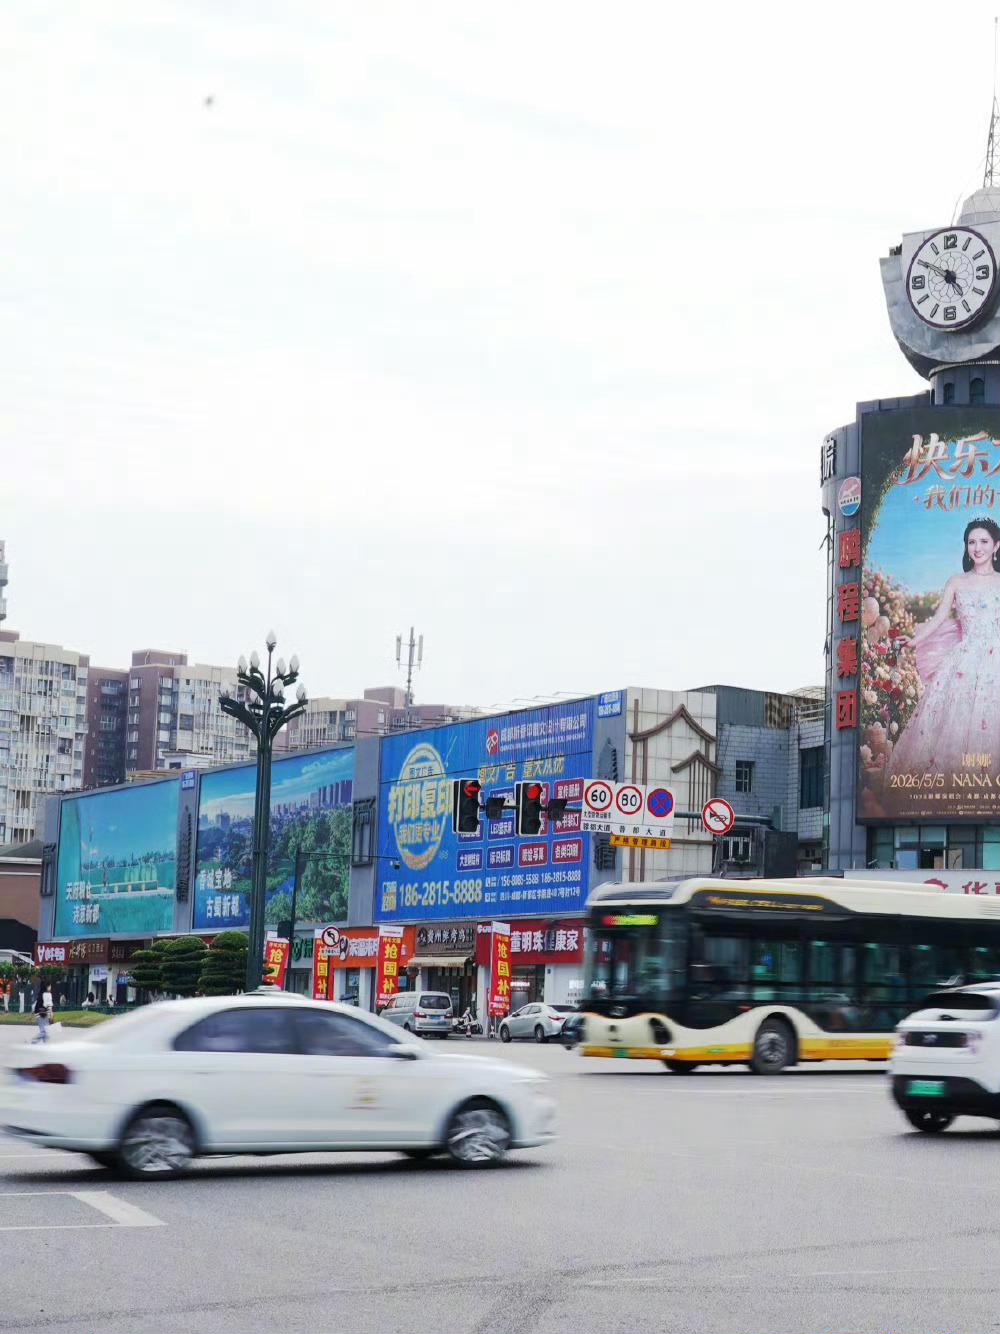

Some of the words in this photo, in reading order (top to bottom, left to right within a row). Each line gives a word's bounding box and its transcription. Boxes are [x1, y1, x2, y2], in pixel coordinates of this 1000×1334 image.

[943, 234, 958, 250] 12
[976, 264, 989, 280] 3
[911, 275, 925, 290] 9
[943, 306, 957, 322] 6
[890, 772, 945, 789] 2026/5/5
[952, 773, 993, 788] NANA
[591, 789, 607, 803] 60
[621, 793, 638, 807] 80
[399, 879, 483, 907] 186-2815-8888
[510, 929, 579, 953] 董明珠健康家
[383, 944, 398, 994] 抢国补
[497, 943, 510, 996] 抢国补
